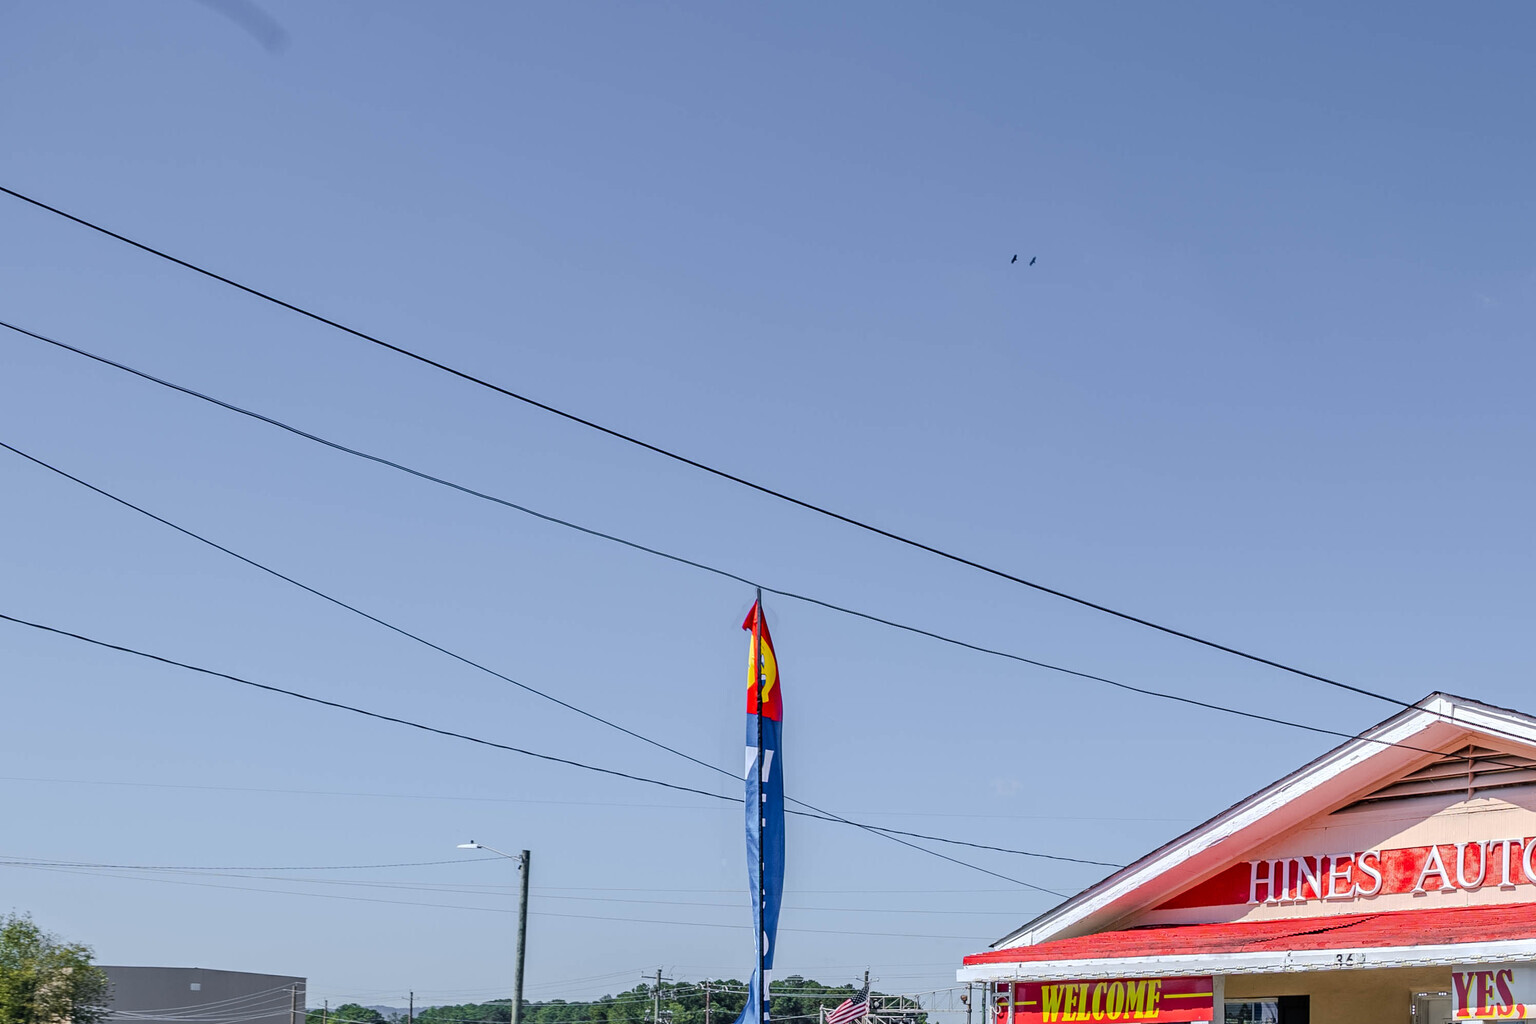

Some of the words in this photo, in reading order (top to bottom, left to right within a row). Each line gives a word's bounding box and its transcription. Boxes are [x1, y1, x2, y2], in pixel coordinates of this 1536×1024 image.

[1247, 849, 1382, 904] HINES
[1041, 979, 1162, 1023] WELCOME
[1452, 968, 1528, 1020] YES,
